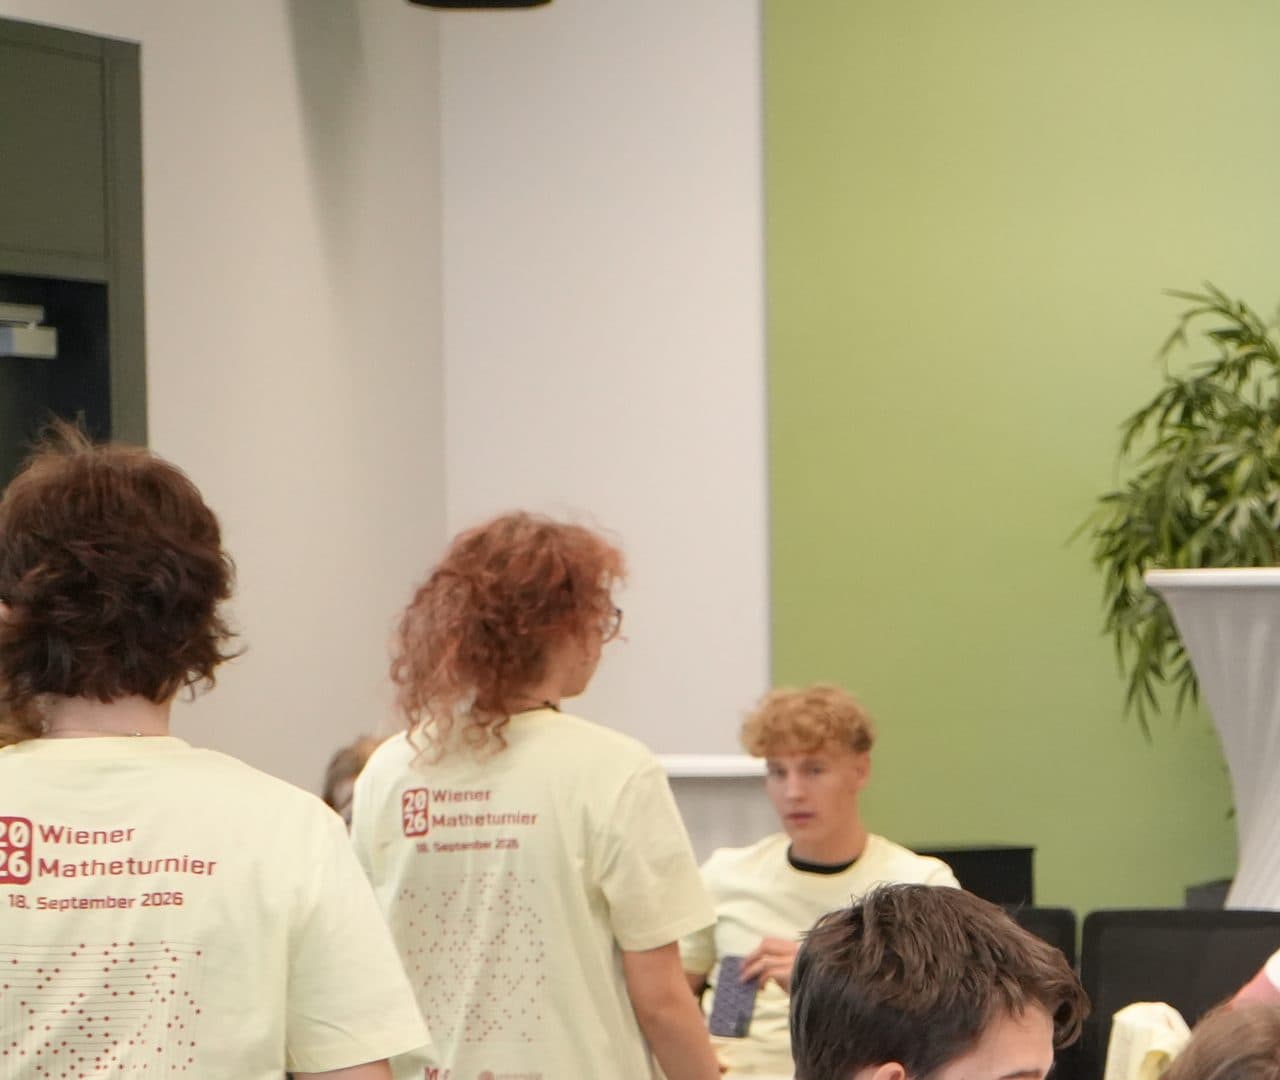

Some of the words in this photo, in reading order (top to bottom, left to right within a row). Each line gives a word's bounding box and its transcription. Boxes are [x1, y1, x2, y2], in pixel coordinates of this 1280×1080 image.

[432, 789, 491, 803] Wiener
[431, 811, 538, 827] Matheturnier
[38, 824, 136, 845] Wiener
[38, 855, 217, 878] Matheturnier
[8, 894, 30, 909] 18.
[36, 896, 136, 912] September
[141, 892, 184, 907] 2026
